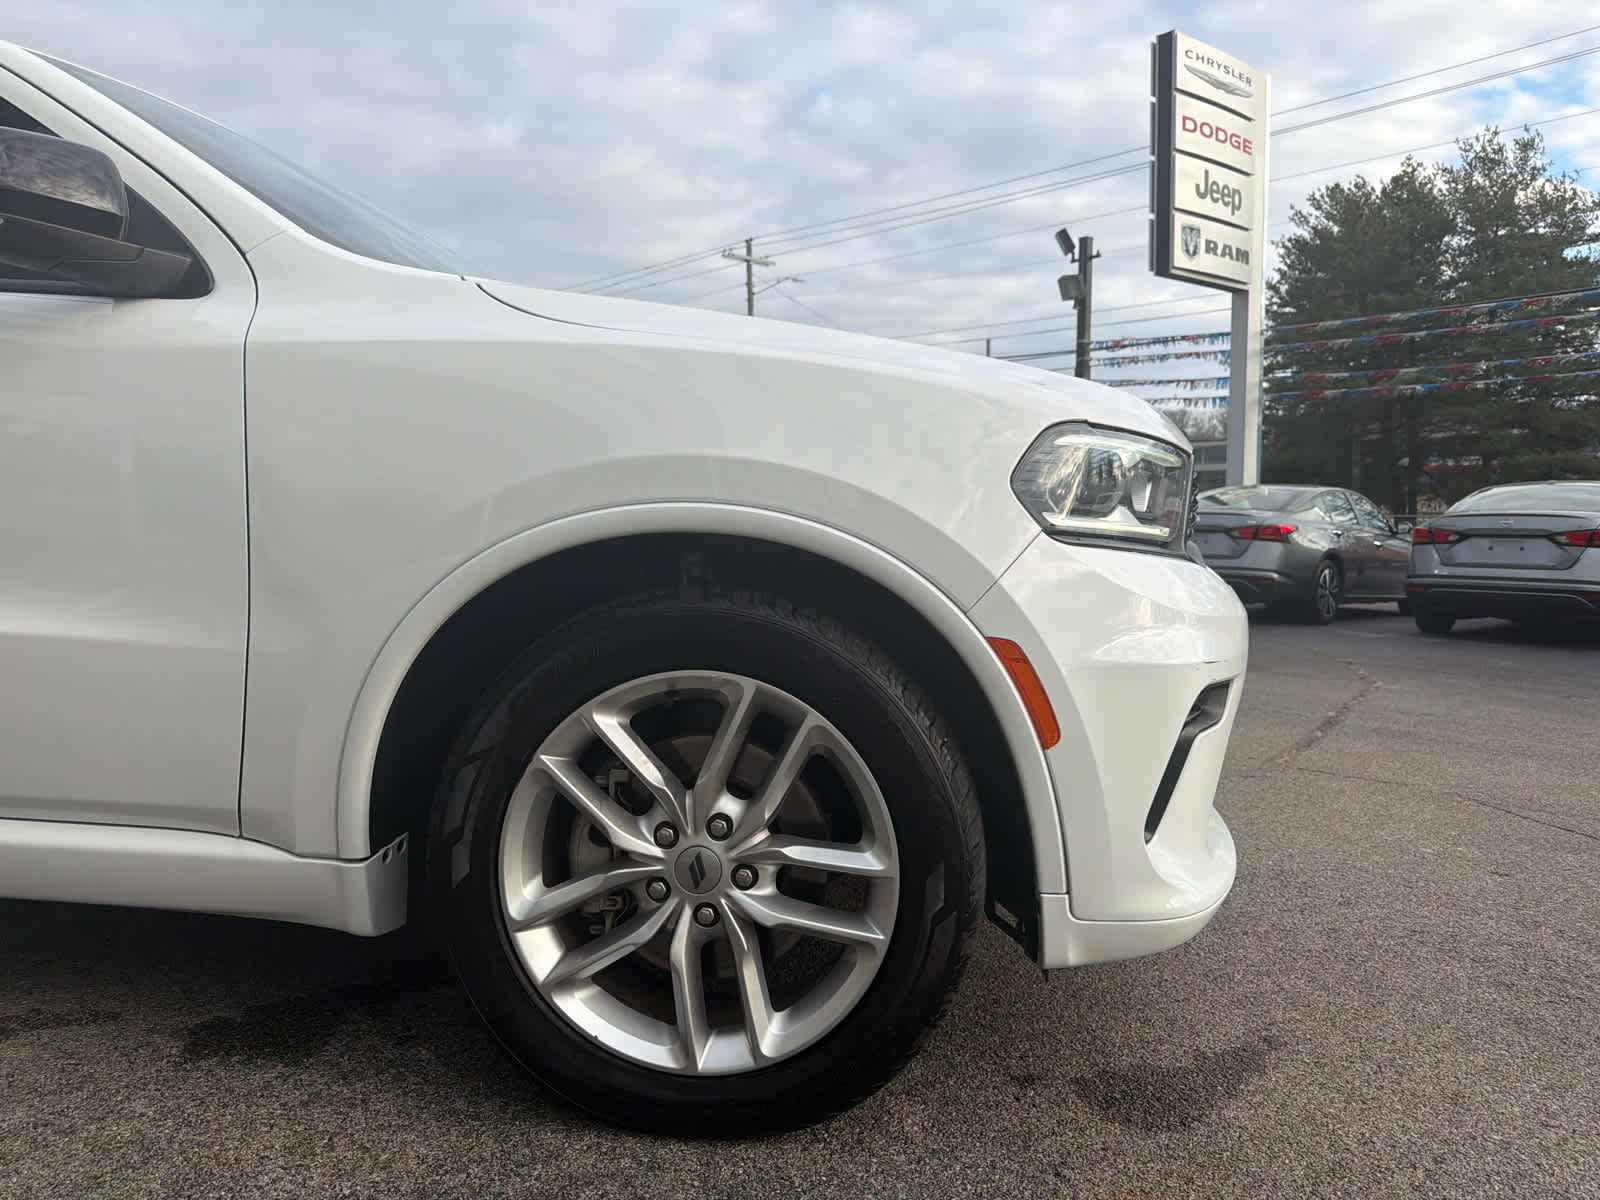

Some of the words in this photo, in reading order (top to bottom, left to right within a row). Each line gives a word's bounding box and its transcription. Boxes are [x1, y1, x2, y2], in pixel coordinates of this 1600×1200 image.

[1184, 49, 1252, 87] CHRYSLER
[1182, 115, 1253, 155] DODGE
[1195, 168, 1242, 216] Jeep
[1204, 239, 1250, 265] RAM
